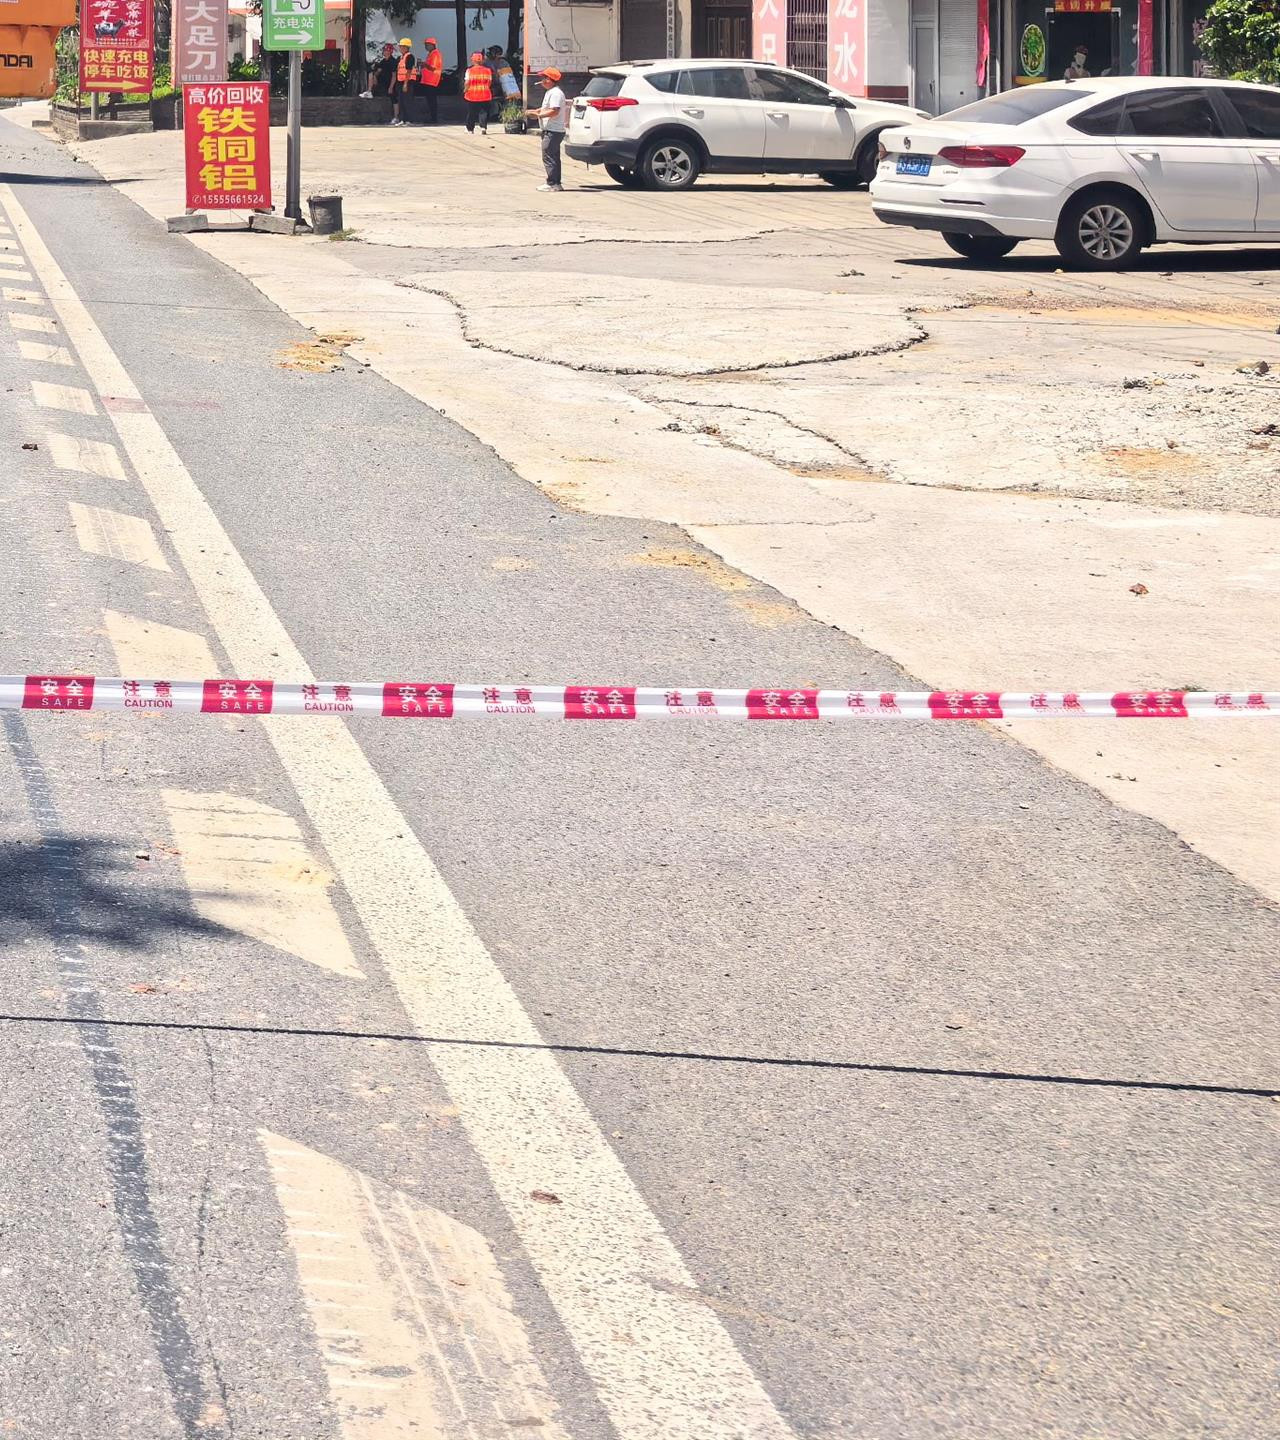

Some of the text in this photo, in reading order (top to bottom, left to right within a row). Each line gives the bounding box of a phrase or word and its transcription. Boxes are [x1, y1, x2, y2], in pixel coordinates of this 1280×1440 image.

[273, 17, 315, 30] 充电站
[185, 1, 219, 71] 大足刀
[83, 49, 148, 64] 快速充电
[83, 64, 149, 79] 停车吃饭
[188, 87, 264, 105] 高价回收
[197, 106, 257, 191] 铁铜铝
[202, 194, 264, 205] 15555661524
[41, 679, 85, 697] 安全
[122, 681, 172, 698] 注意
[220, 682, 265, 699] 安全
[302, 683, 352, 701] 注意
[399, 686, 443, 702] 安全
[41, 698, 85, 707] SAFE
[482, 688, 533, 704] 注意
[580, 689, 624, 705] 安全
[664, 691, 715, 706] 注意
[761, 691, 807, 707] 安全
[847, 693, 897, 708] 注意
[944, 693, 990, 708] 安全
[124, 699, 173, 709] CAUTION
[221, 701, 265, 710] SAFE
[304, 702, 354, 712] CAUTION
[402, 704, 446, 713] SAFE
[486, 705, 536, 713] CAUTION
[584, 705, 629, 714] SAFE
[767, 707, 813, 716] SAFE
